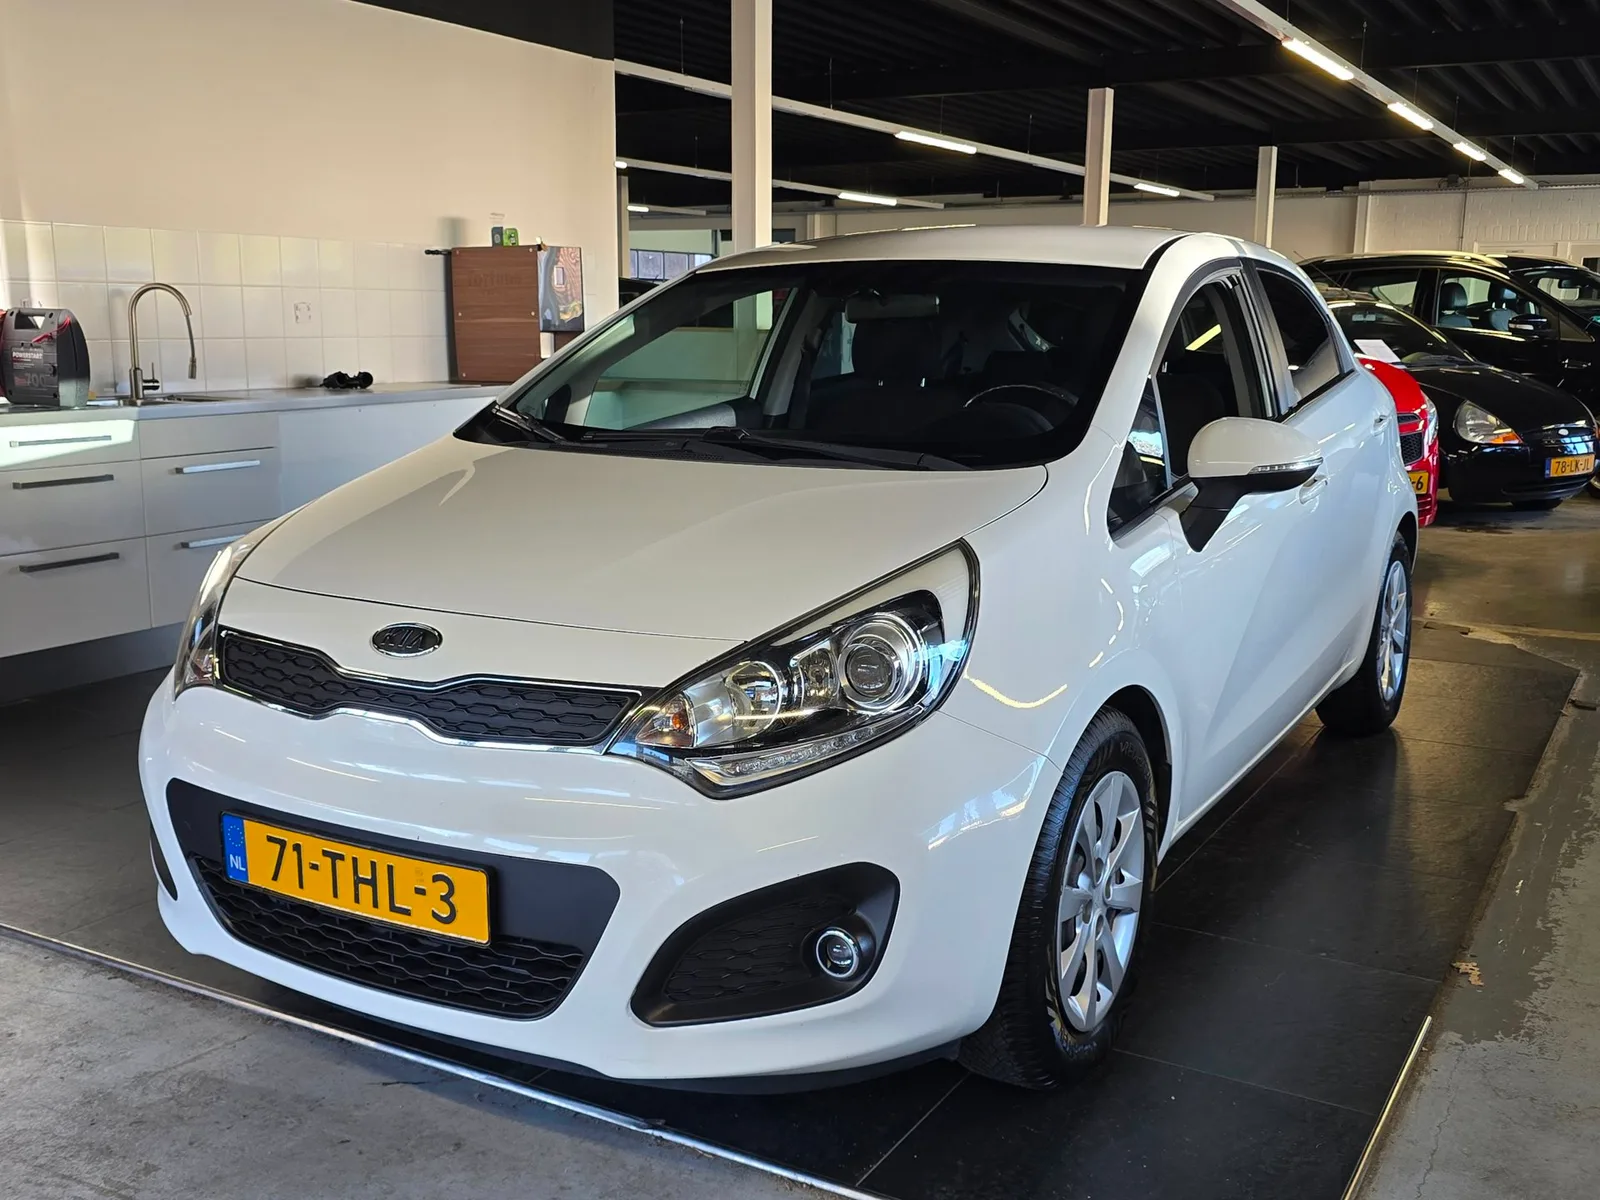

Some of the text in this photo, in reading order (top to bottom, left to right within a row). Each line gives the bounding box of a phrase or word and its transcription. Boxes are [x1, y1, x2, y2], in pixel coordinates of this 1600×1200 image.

[1554, 458, 1590, 474] 78-LK-JL
[229, 853, 246, 872] NL
[265, 834, 458, 925] 71-THL-3
